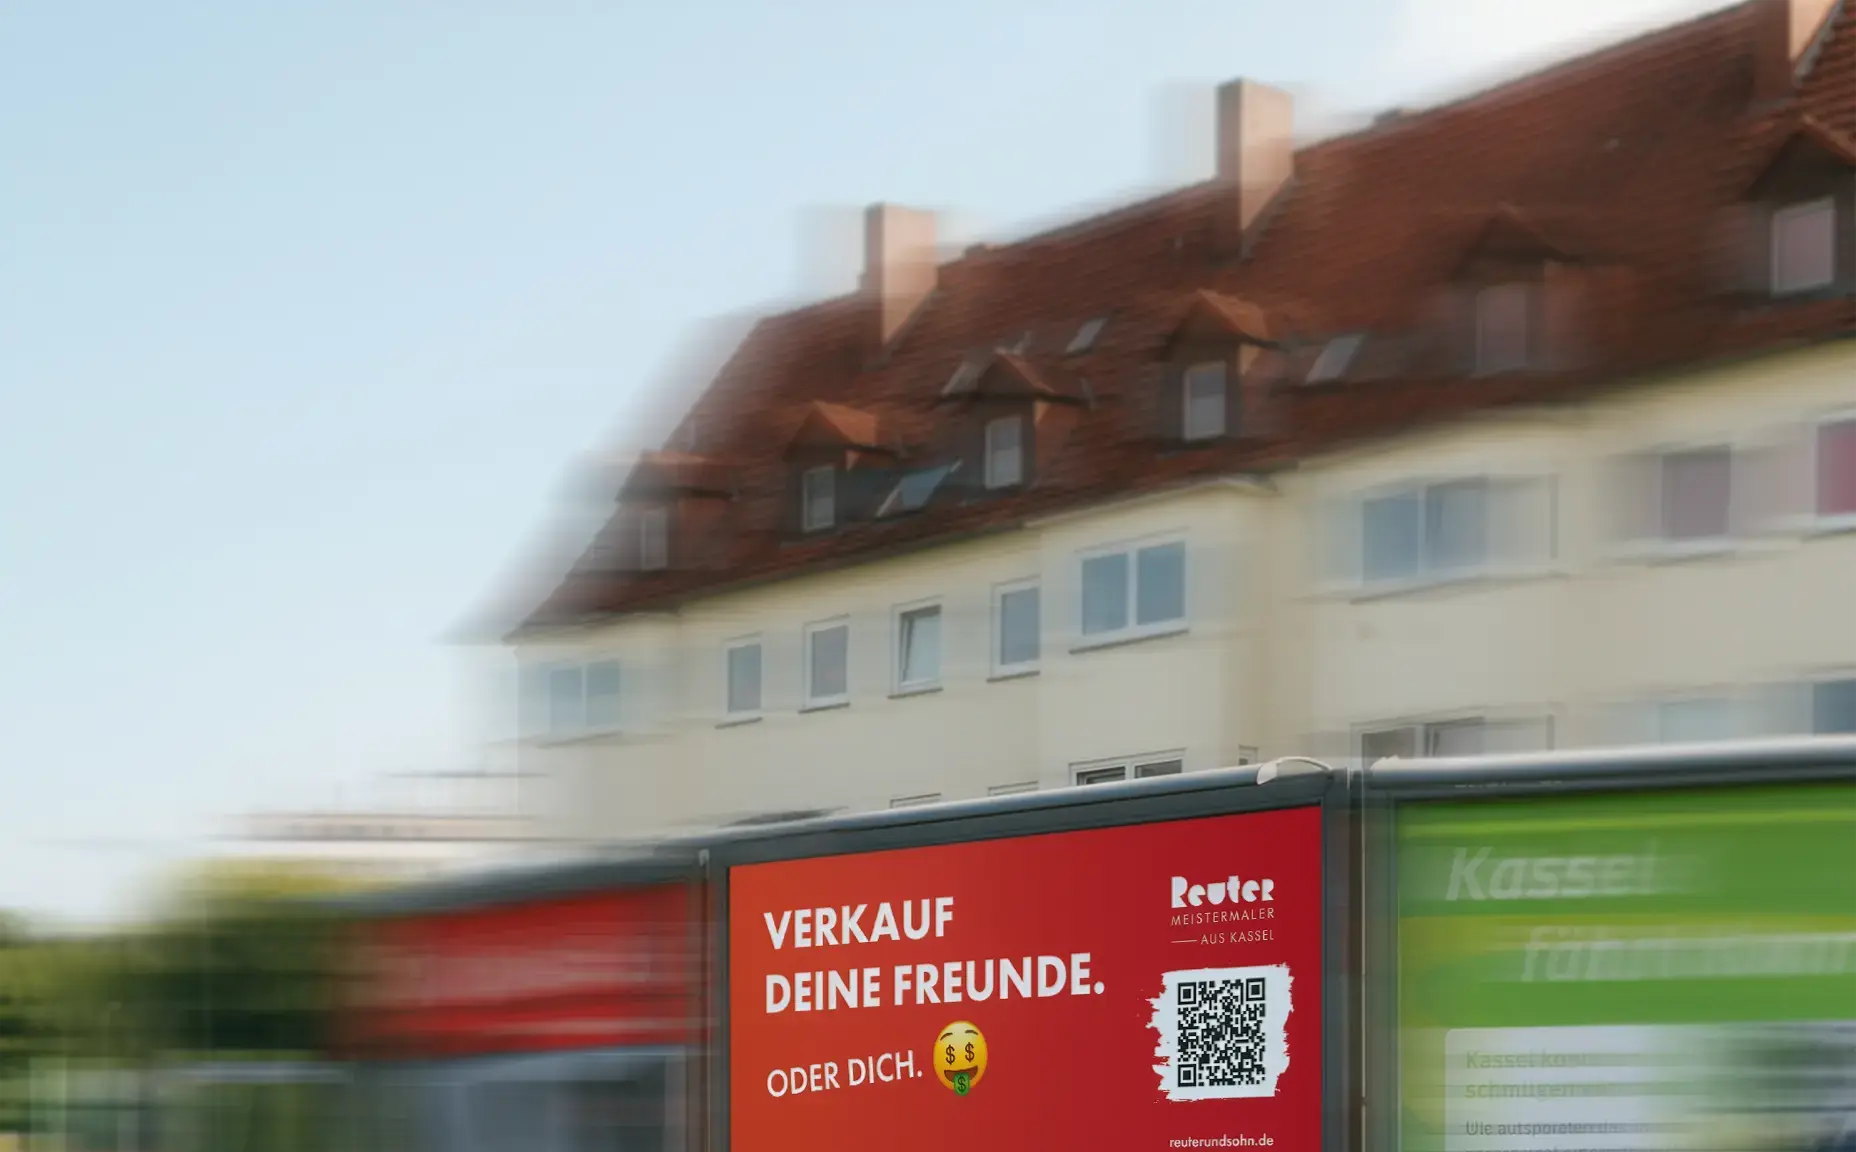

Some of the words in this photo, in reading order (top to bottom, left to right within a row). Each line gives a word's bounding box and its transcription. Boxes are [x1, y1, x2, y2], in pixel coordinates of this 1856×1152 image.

[1171, 875, 1275, 909] Reuter
[763, 896, 954, 950] VERKAUF
[1171, 907, 1275, 926] MEISTERMALER
[1200, 932, 1225, 945] AUS
[1230, 929, 1275, 943] KASSEL
[765, 966, 880, 1014] DEINE
[894, 952, 1105, 1006] FREUNDE.
[766, 1061, 841, 1098] ODER
[847, 1049, 923, 1087] DICH.
[1169, 1133, 1274, 1148] reuterundsohn.de
